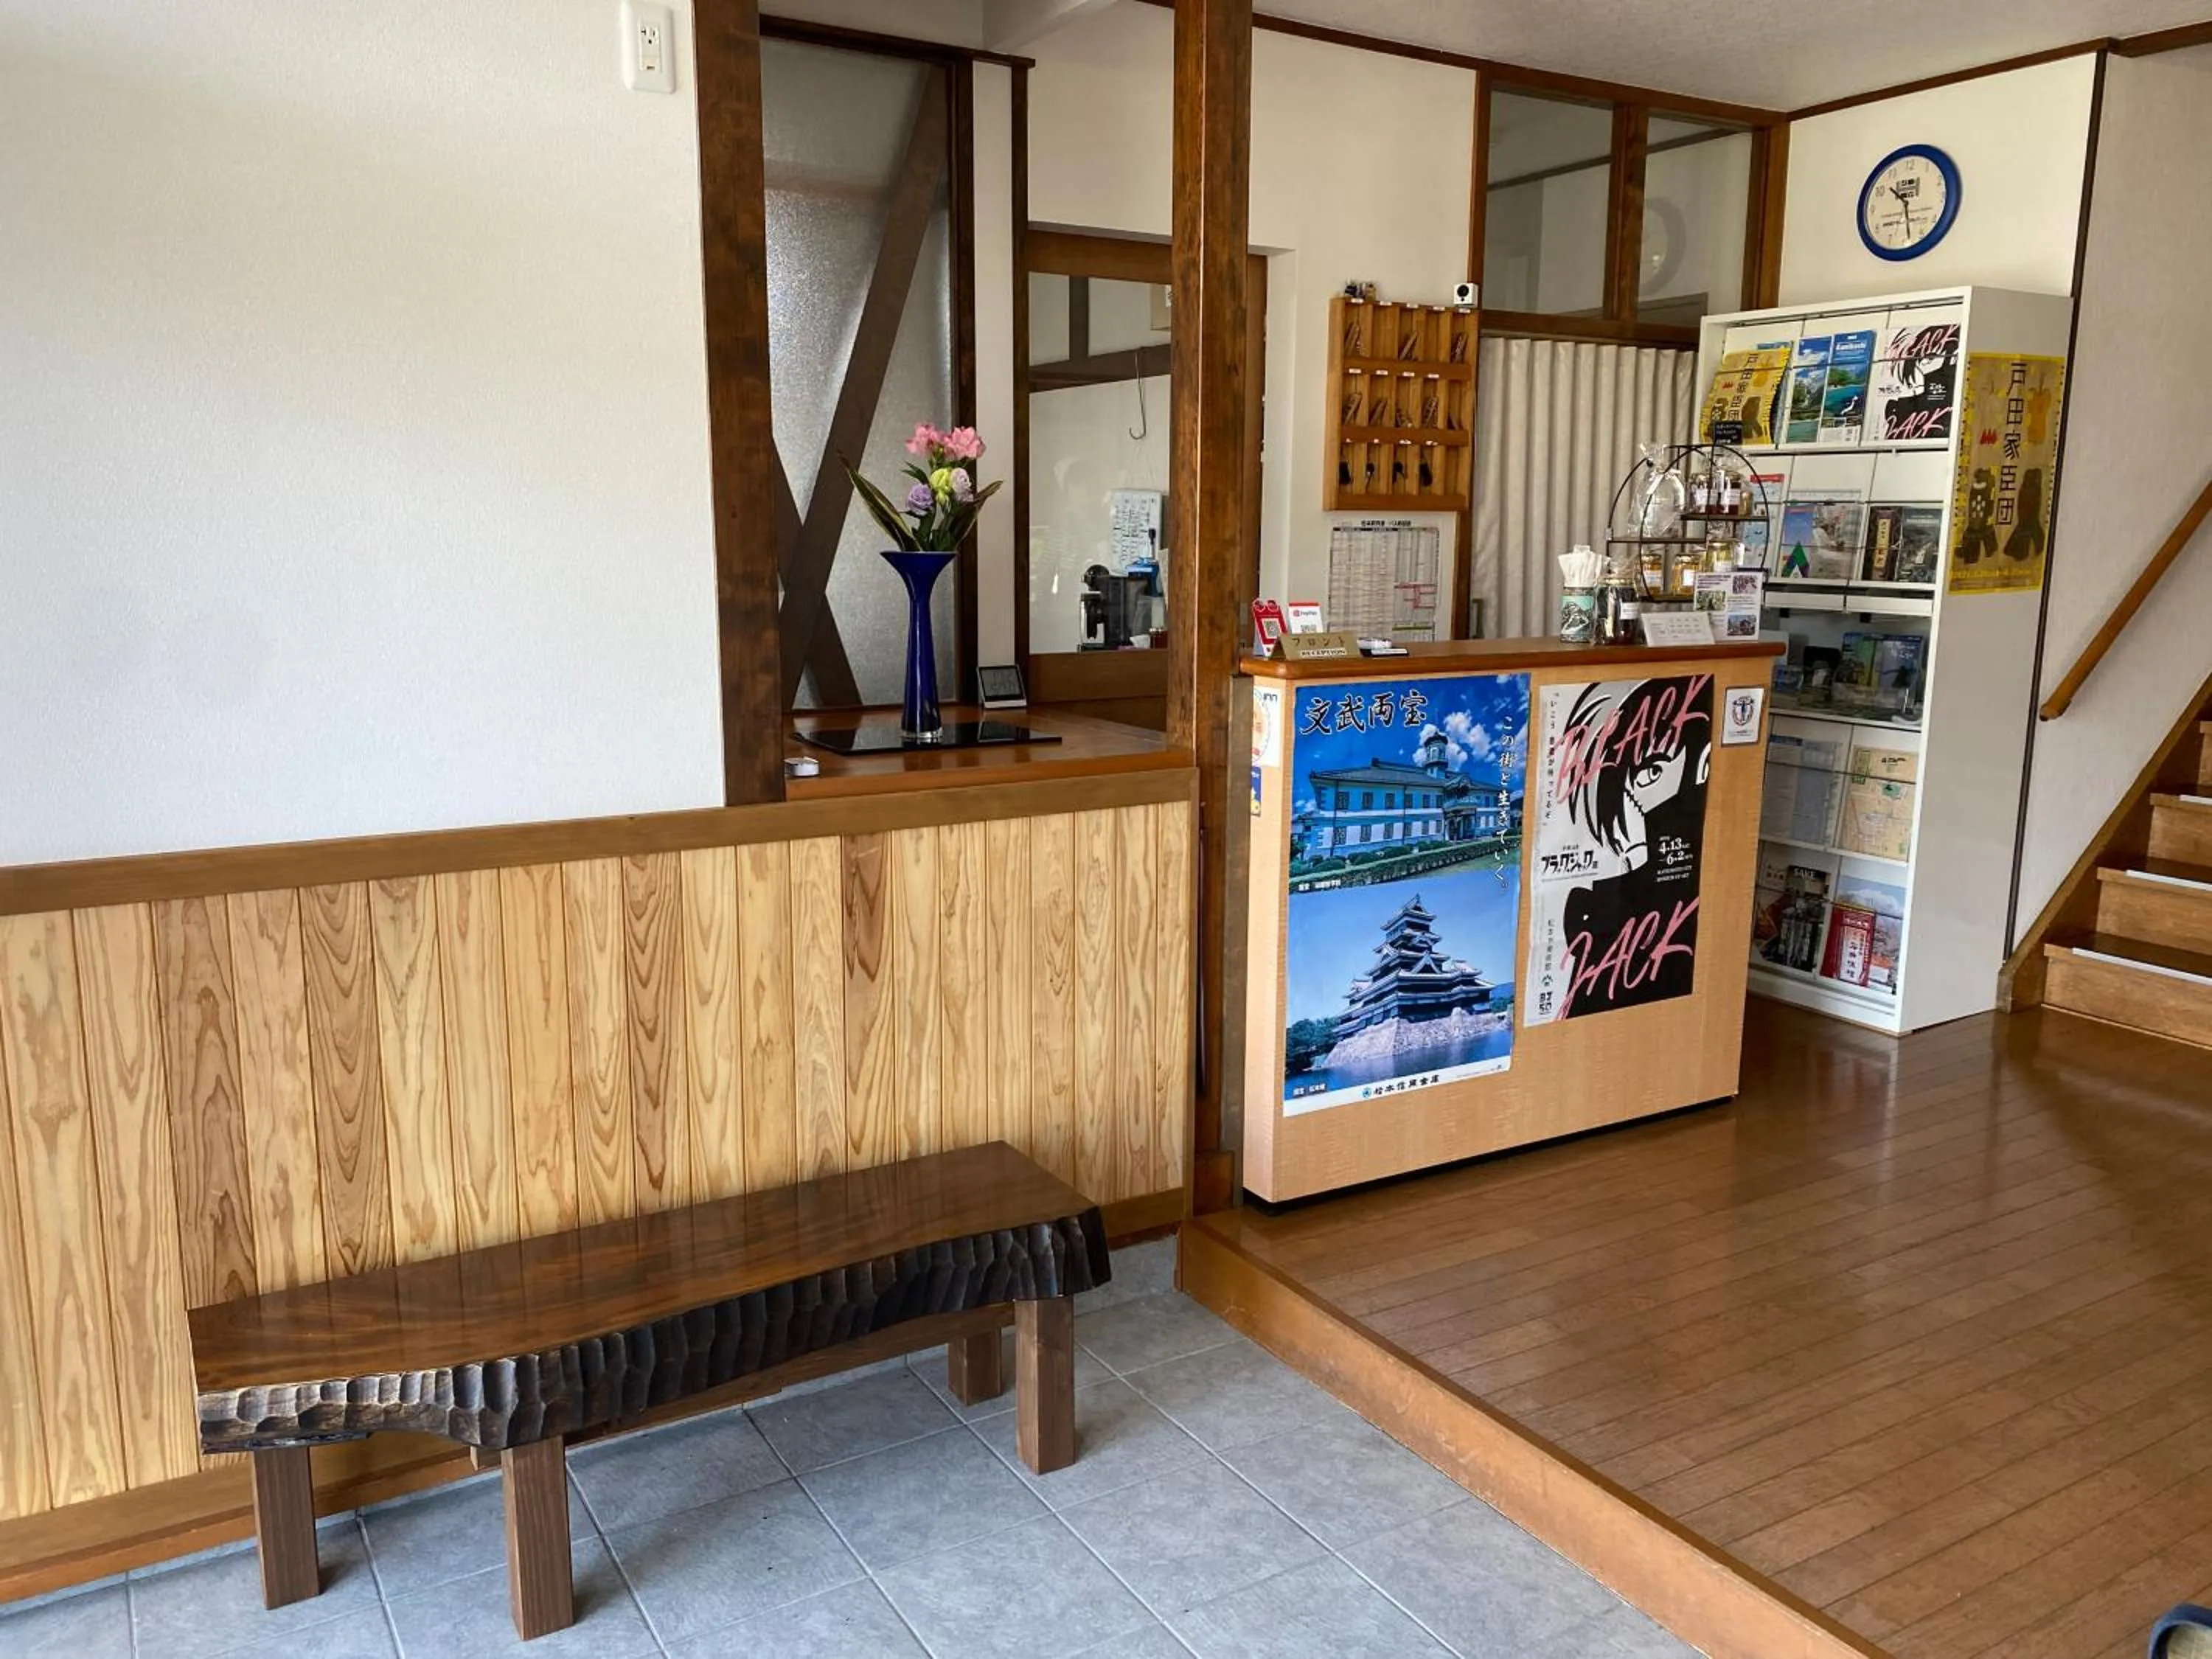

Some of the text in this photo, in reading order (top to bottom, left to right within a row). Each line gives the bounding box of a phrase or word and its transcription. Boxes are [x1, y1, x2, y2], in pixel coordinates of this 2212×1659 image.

[1885, 406, 1954, 440] JACK
[1996, 363, 2027, 525] 戸田家臣団
[1292, 636, 1346, 647] フロント
[1300, 689, 1428, 735] 文武両宝
[1554, 672, 1712, 804] BLACK
[1659, 838, 1682, 854] 4.13
[1667, 850, 1685, 865] 6.2
[1559, 897, 1700, 1020] JACK
